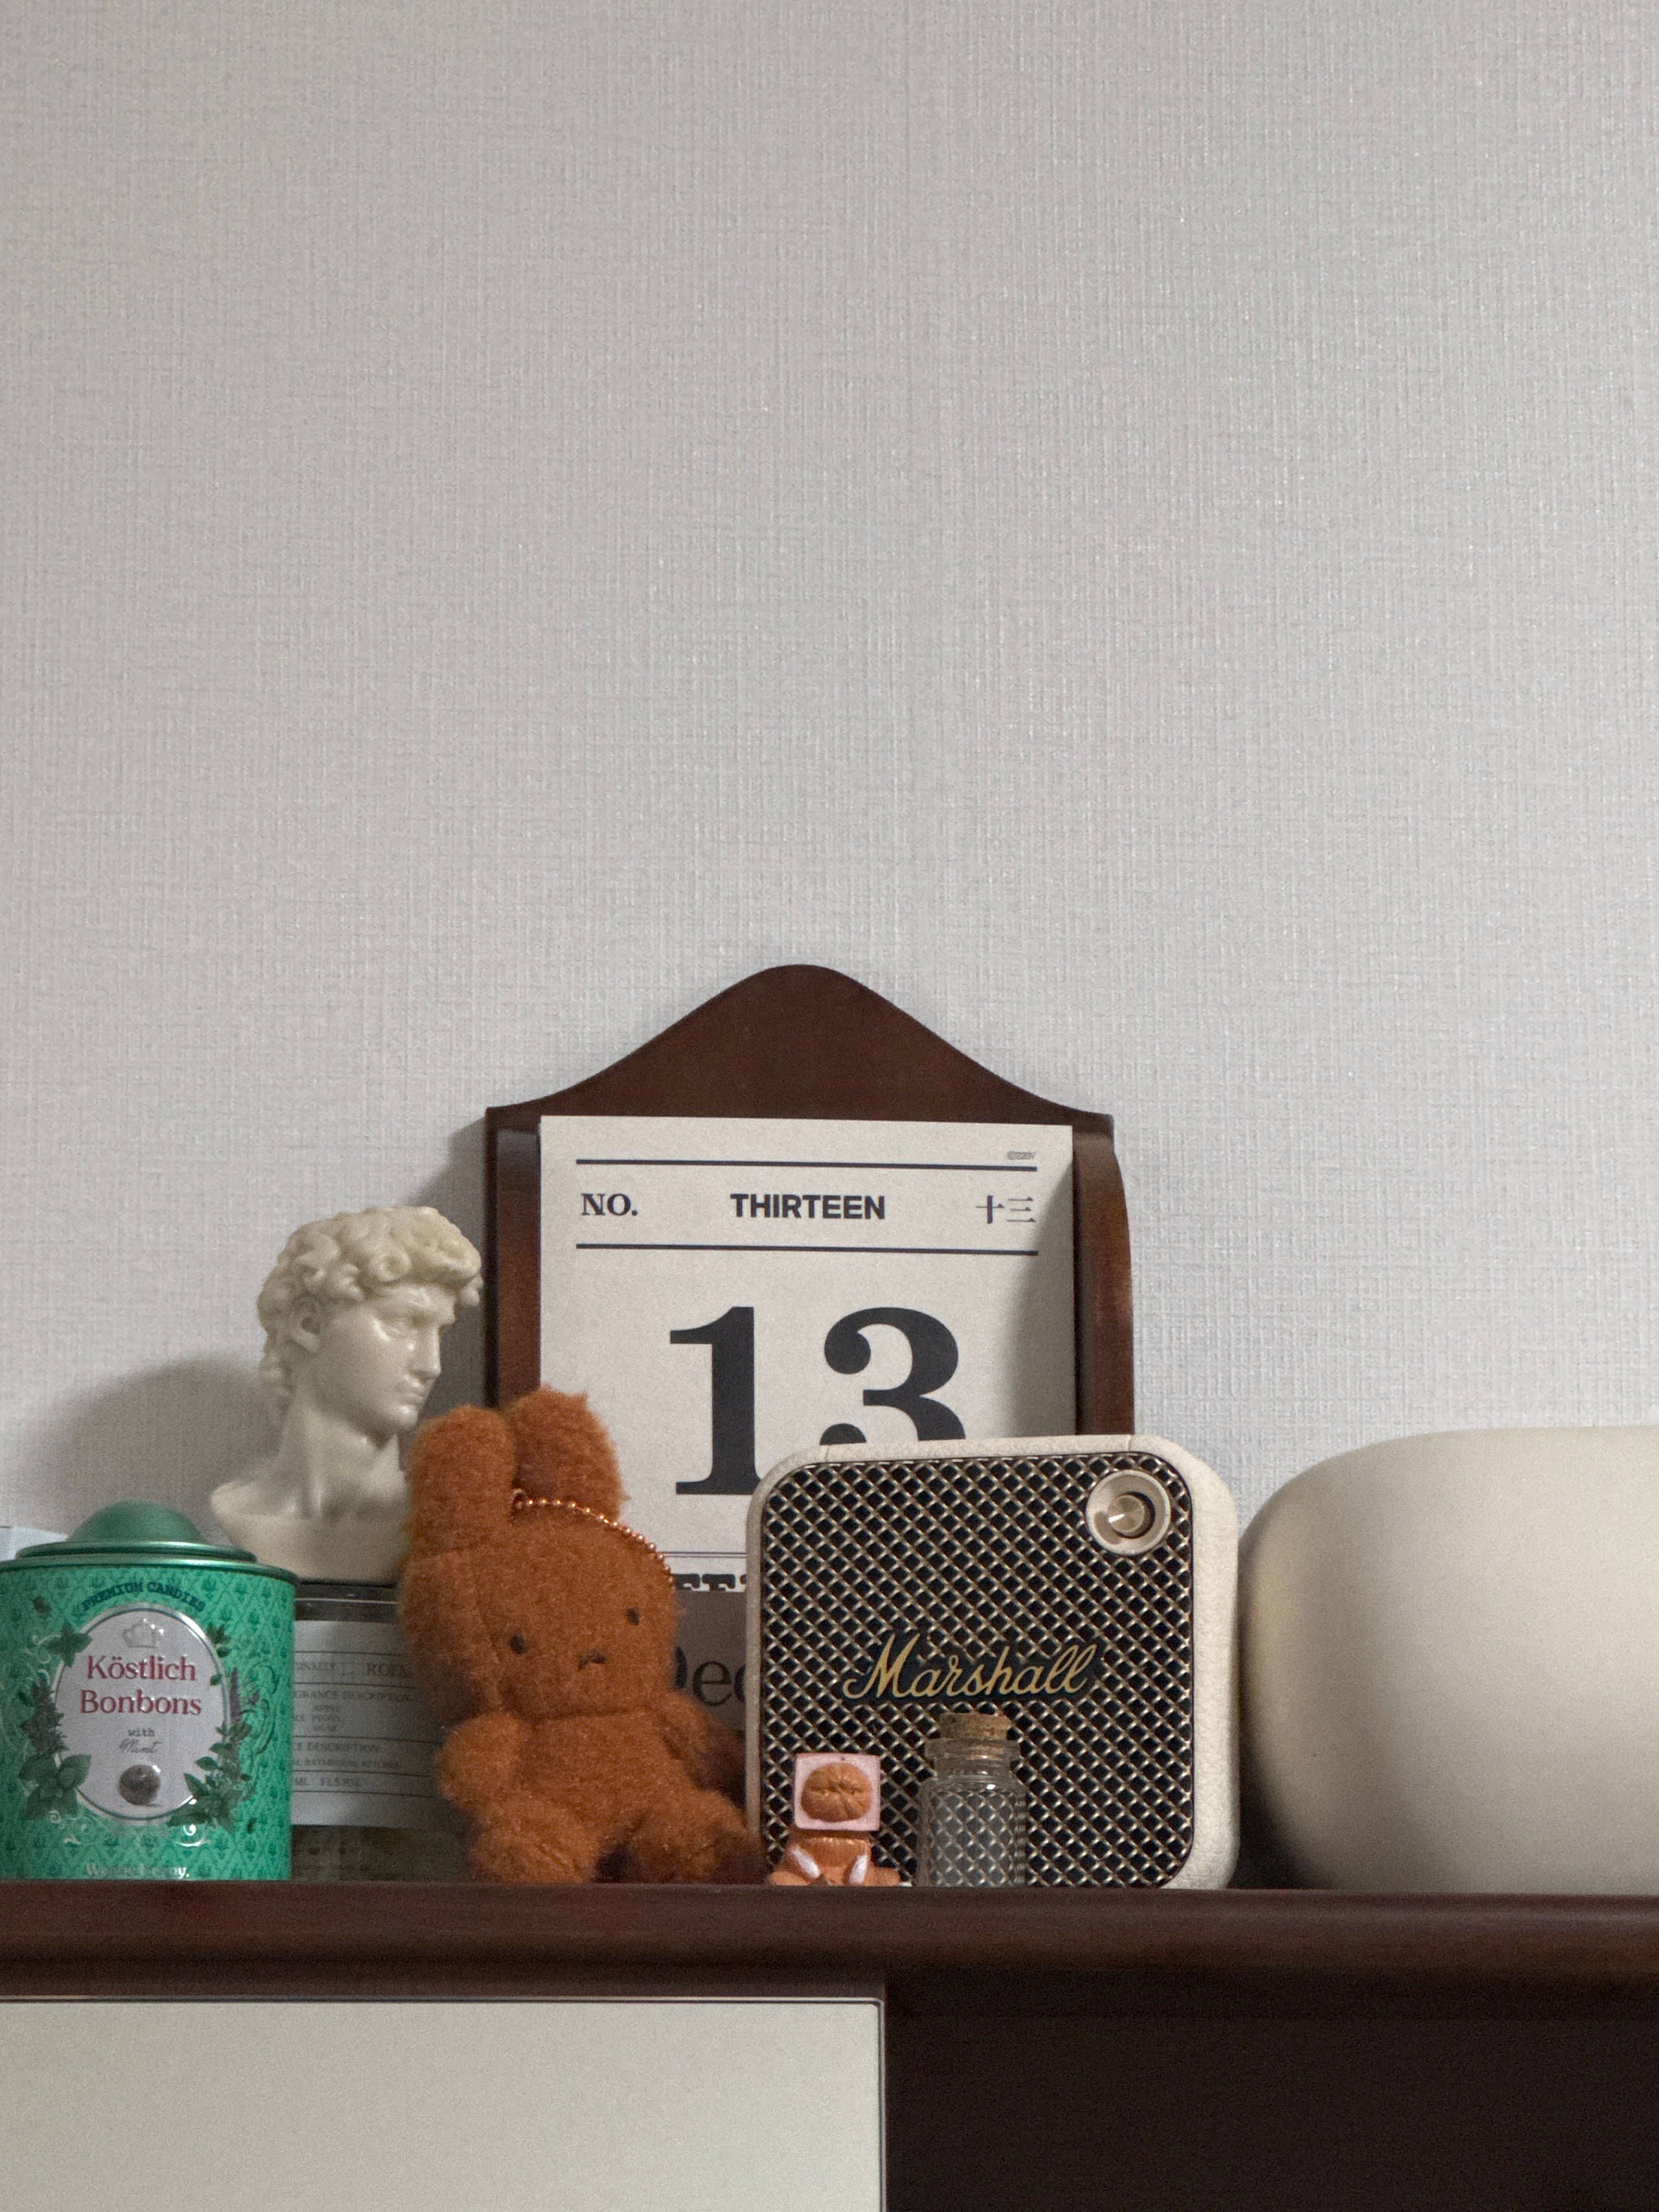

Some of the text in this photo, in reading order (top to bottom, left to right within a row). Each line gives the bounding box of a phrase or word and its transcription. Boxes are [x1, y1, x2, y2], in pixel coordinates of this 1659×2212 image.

[581, 1193, 638, 1216] NO.
[730, 1194, 885, 1220] THIRTEEN
[976, 1195, 1036, 1224] 十三
[670, 1306, 966, 1496] 13
[82, 1581, 206, 1612] PREMIUM CANDIES
[87, 1655, 196, 1681] Köstlich
[842, 1633, 1097, 1699] Marshall
[80, 1689, 202, 1716] Bonbons
[128, 1727, 156, 1737] with
